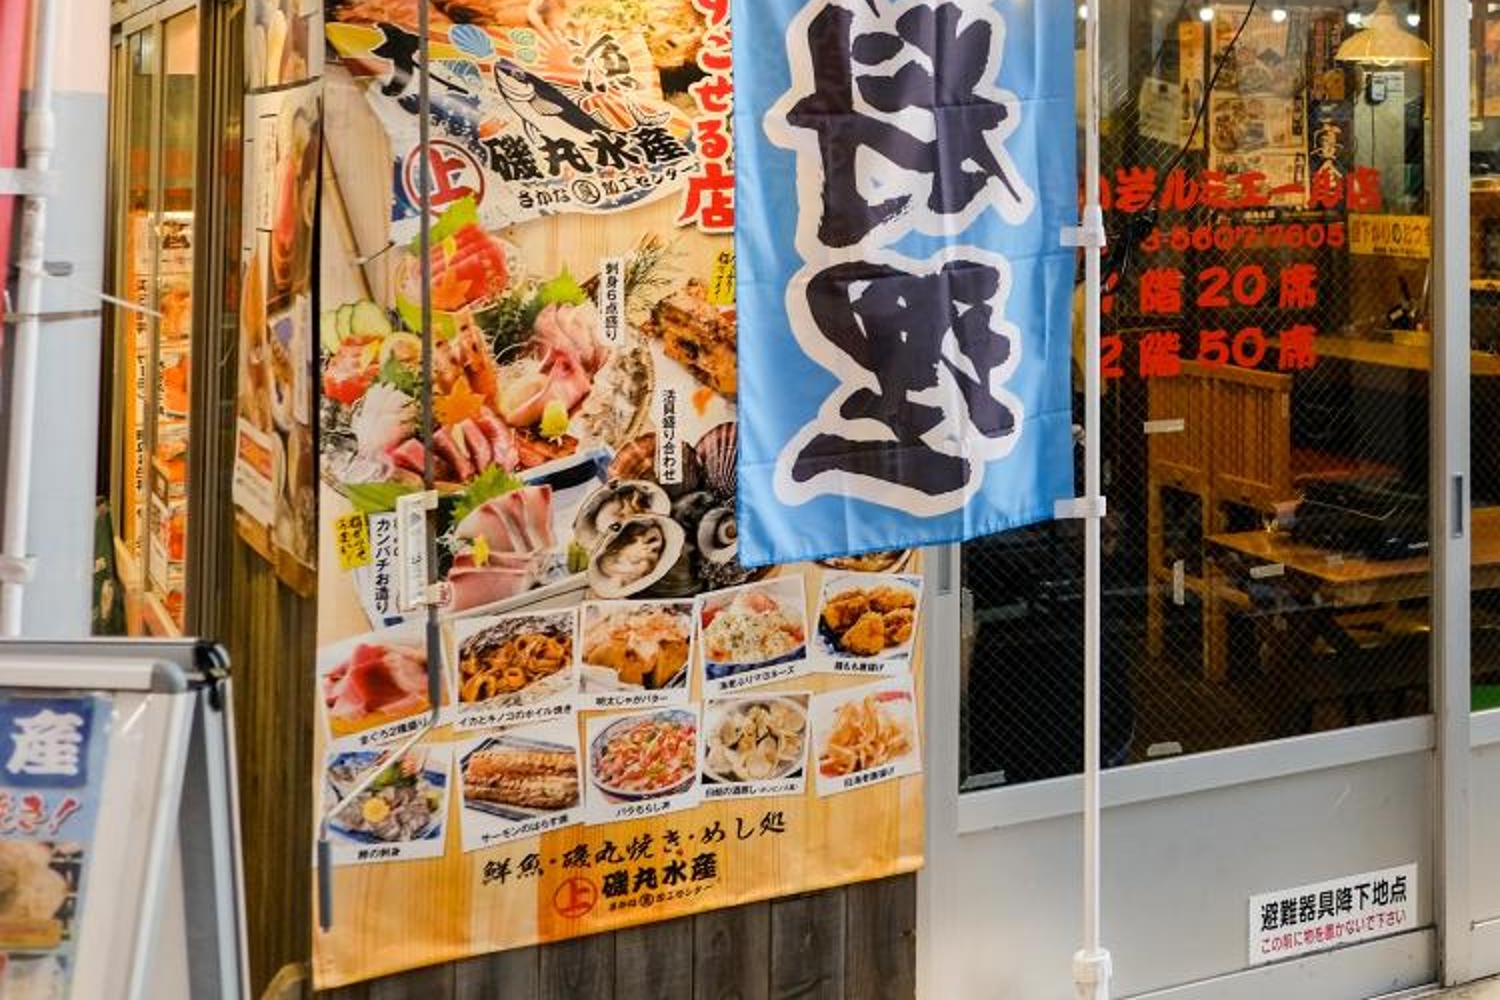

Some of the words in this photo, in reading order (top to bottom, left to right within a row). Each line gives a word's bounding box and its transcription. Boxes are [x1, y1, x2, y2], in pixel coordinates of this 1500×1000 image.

[482, 127, 690, 182] 磯丸水産
[601, 852, 718, 900] 磯丸水産
[1260, 875, 1407, 932] 避難器具降下地点
